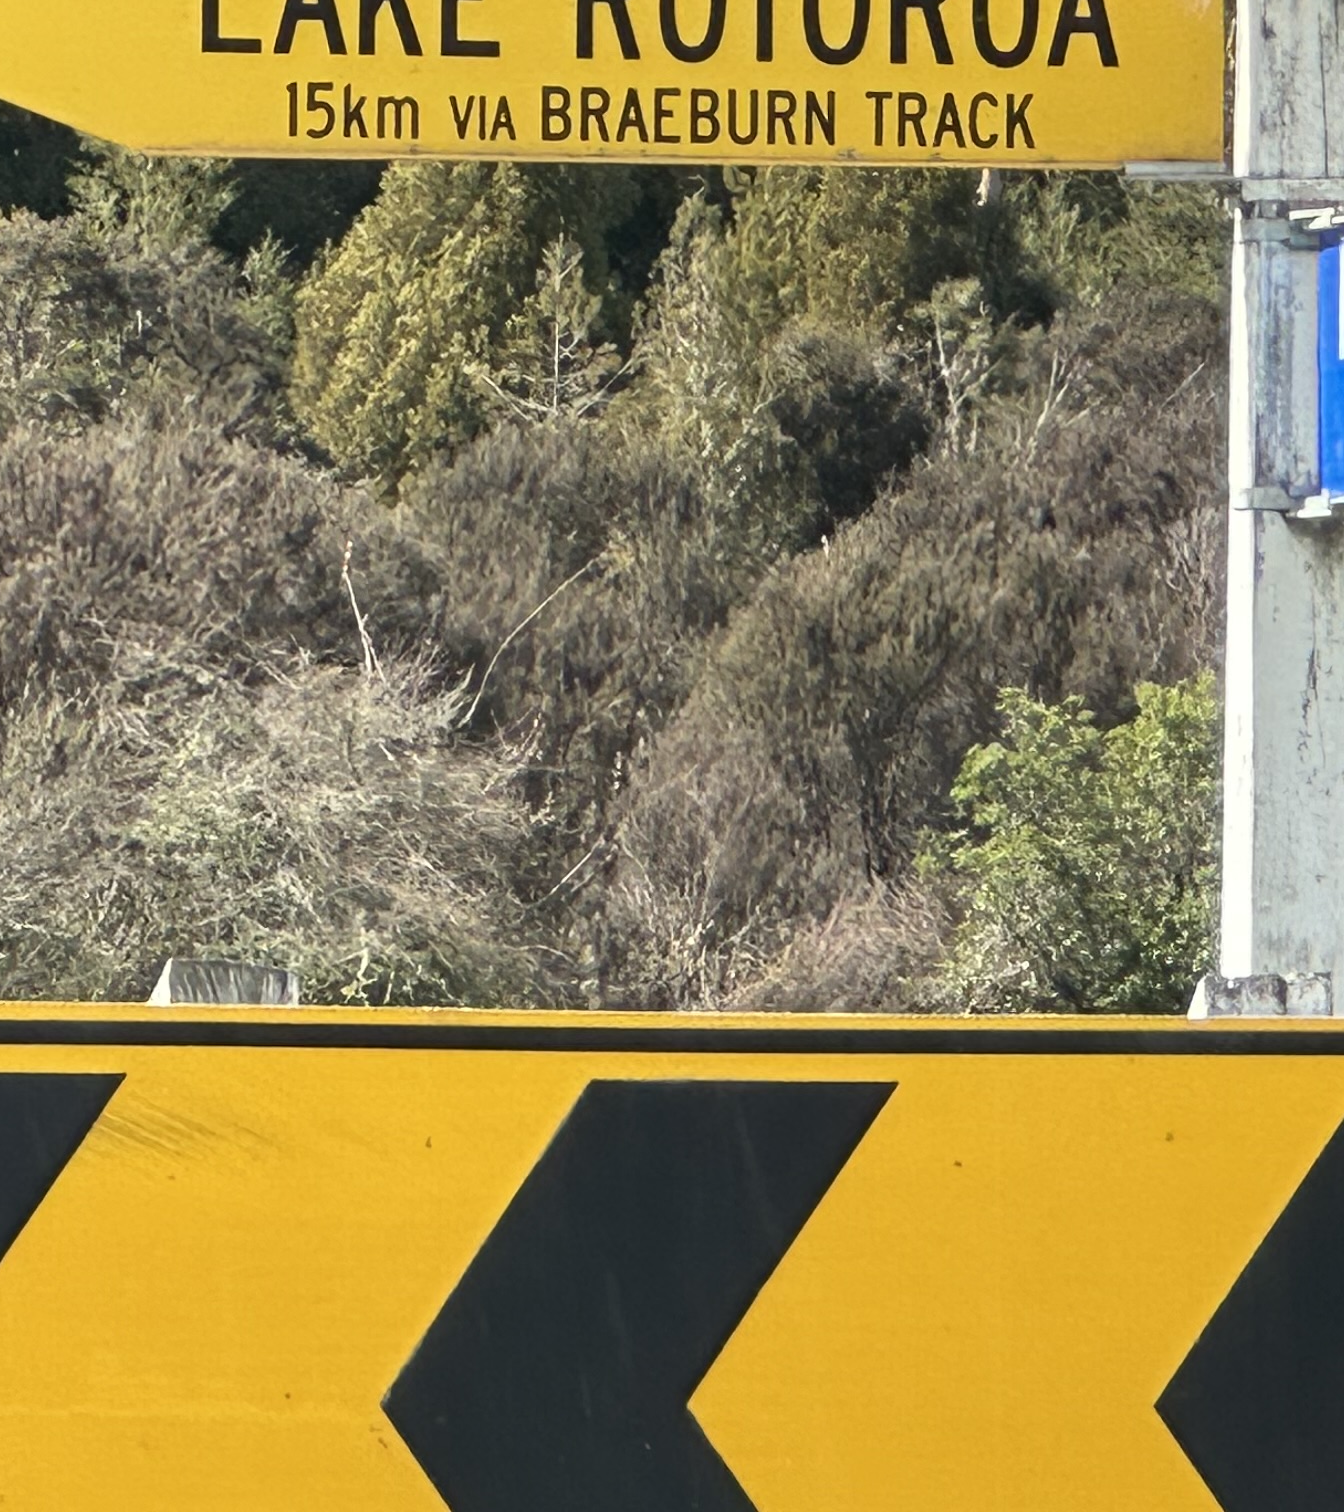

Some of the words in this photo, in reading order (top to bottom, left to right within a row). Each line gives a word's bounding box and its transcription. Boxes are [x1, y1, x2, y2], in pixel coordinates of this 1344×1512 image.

[286, 81, 419, 141] 15km
[448, 95, 517, 141] VIA
[541, 85, 836, 146] BRAEBURN
[865, 91, 1036, 149] TRACK
